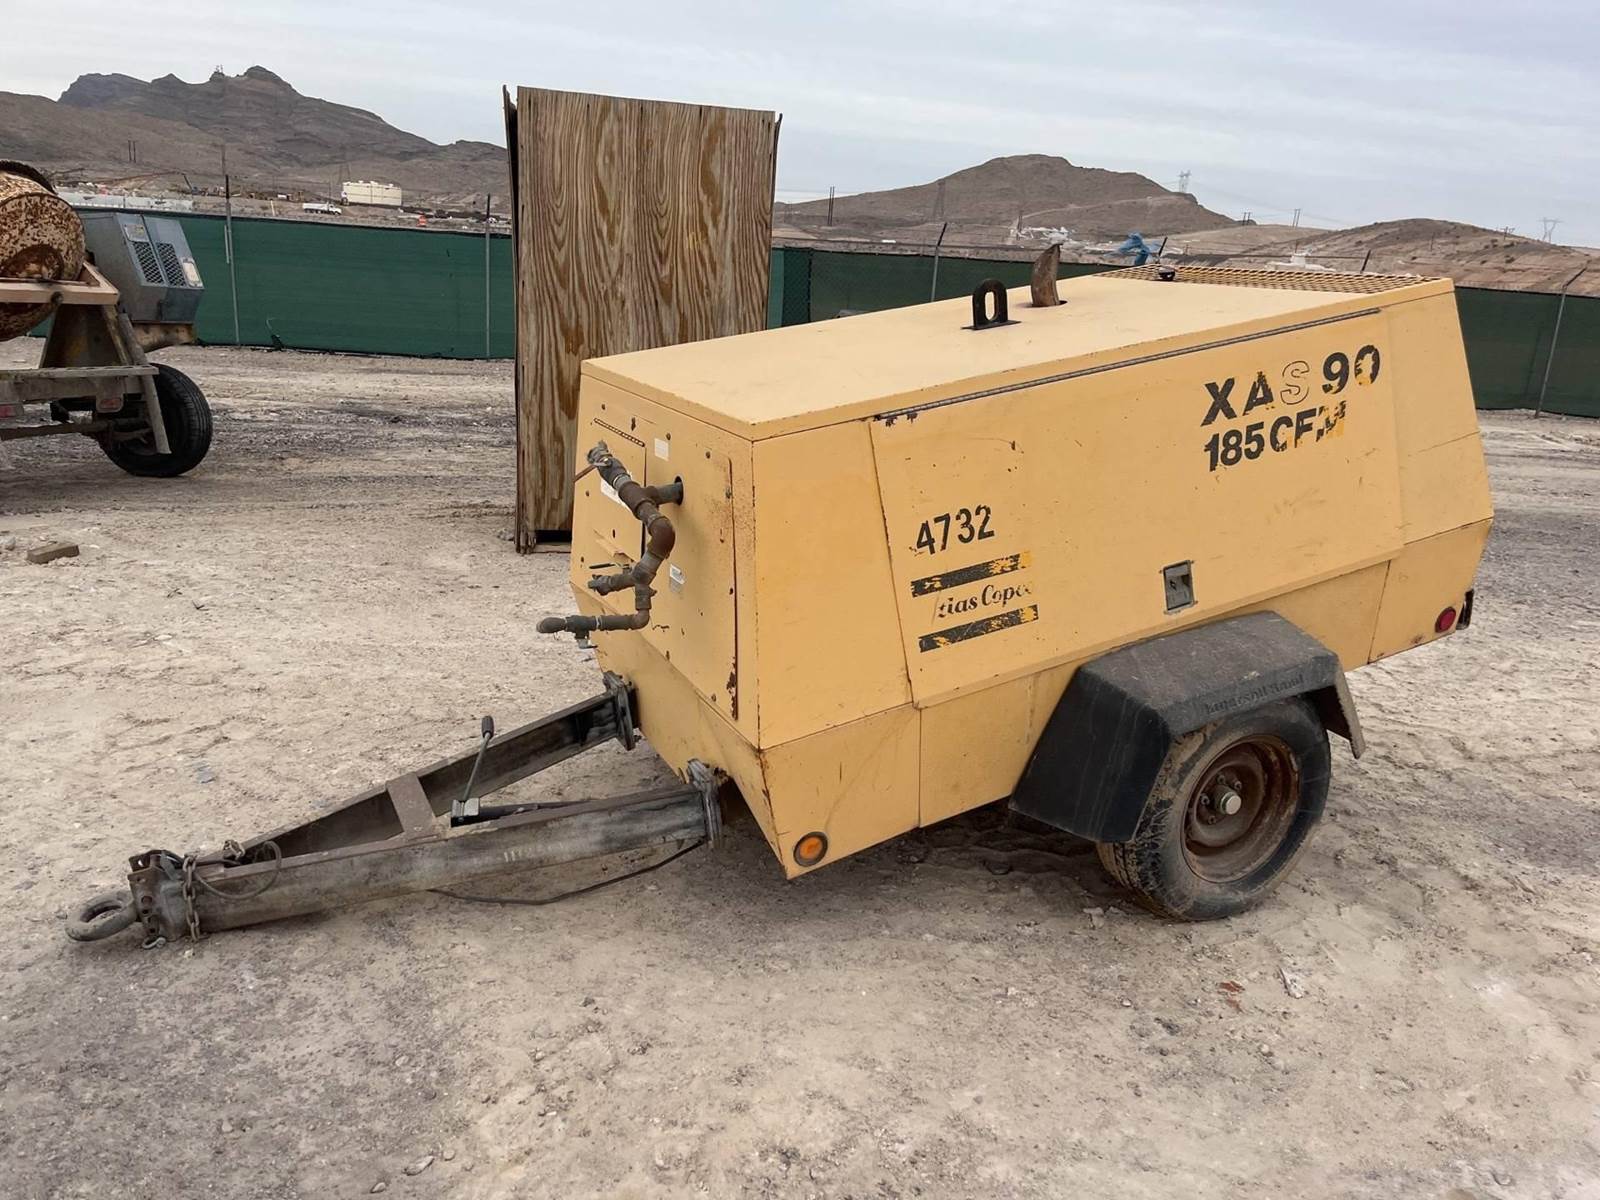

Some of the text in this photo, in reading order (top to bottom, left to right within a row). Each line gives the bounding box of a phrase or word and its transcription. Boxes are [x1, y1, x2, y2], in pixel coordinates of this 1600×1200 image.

[1200, 344, 1381, 427] XAS 90
[916, 504, 995, 555] 4732
